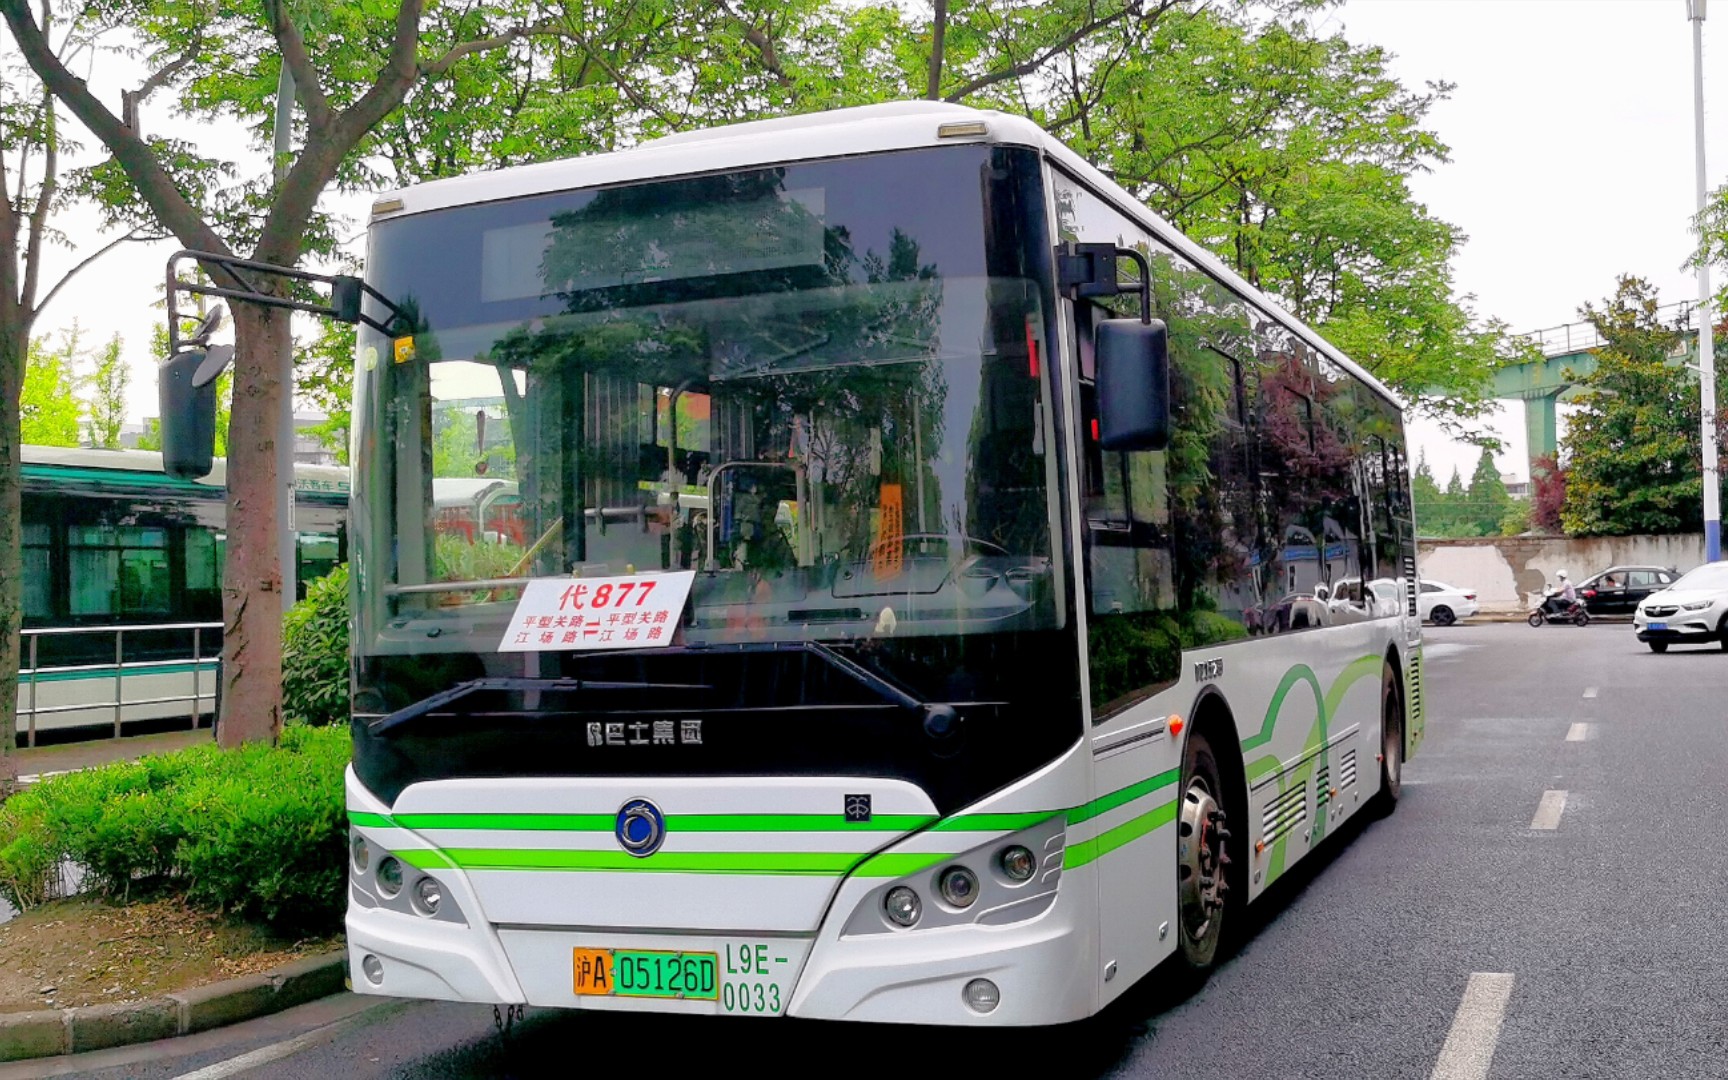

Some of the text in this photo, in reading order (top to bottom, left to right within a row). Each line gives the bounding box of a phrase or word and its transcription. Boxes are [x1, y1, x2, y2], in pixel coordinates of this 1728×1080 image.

[522, 609, 669, 629] 平型关路 平型关路
[723, 982, 781, 1013] 0033
